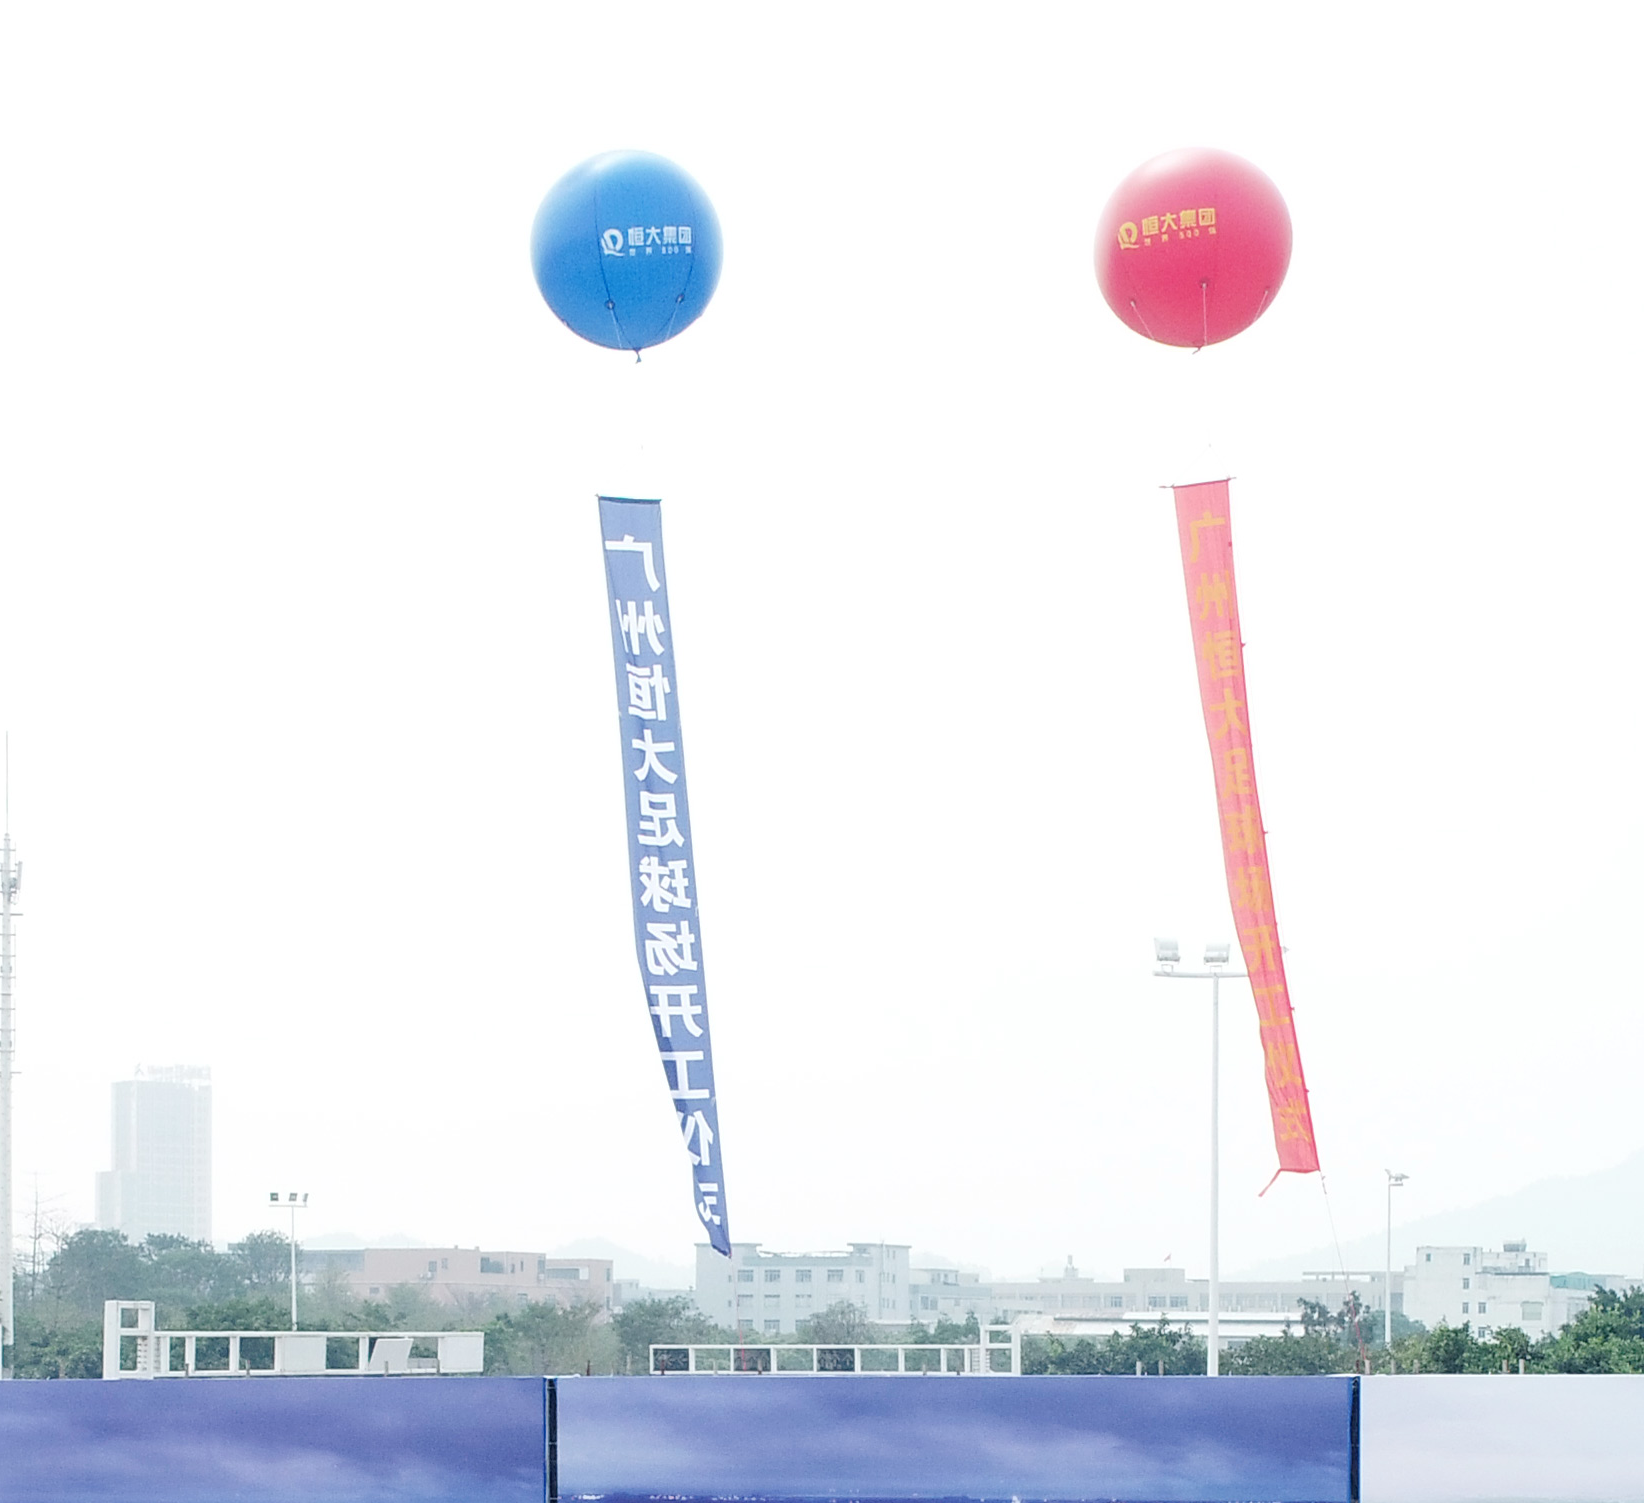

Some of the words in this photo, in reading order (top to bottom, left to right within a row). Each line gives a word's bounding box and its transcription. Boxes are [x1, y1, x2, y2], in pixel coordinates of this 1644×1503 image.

[1141, 207, 1216, 236] 恒大集团
[627, 226, 692, 246] 恒大集团
